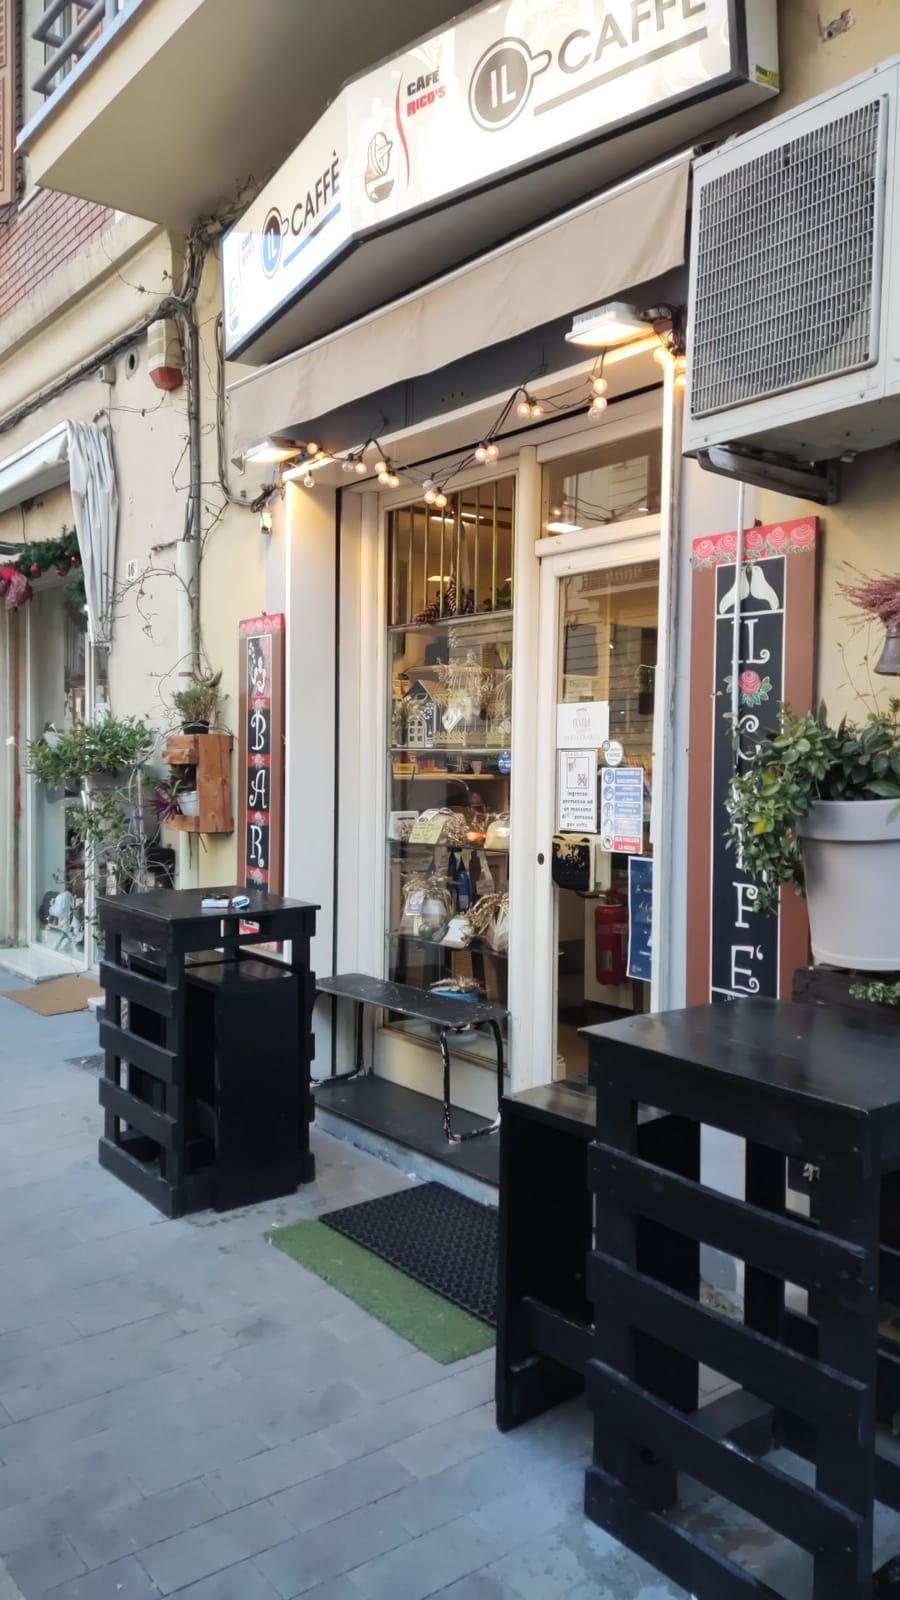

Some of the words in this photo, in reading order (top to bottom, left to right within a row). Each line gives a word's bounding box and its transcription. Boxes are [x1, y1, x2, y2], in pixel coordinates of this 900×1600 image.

[407, 86, 445, 117] RICO'S
[490, 63, 517, 109] IL
[267, 227, 278, 262] IL
[249, 710, 268, 868] BAR
